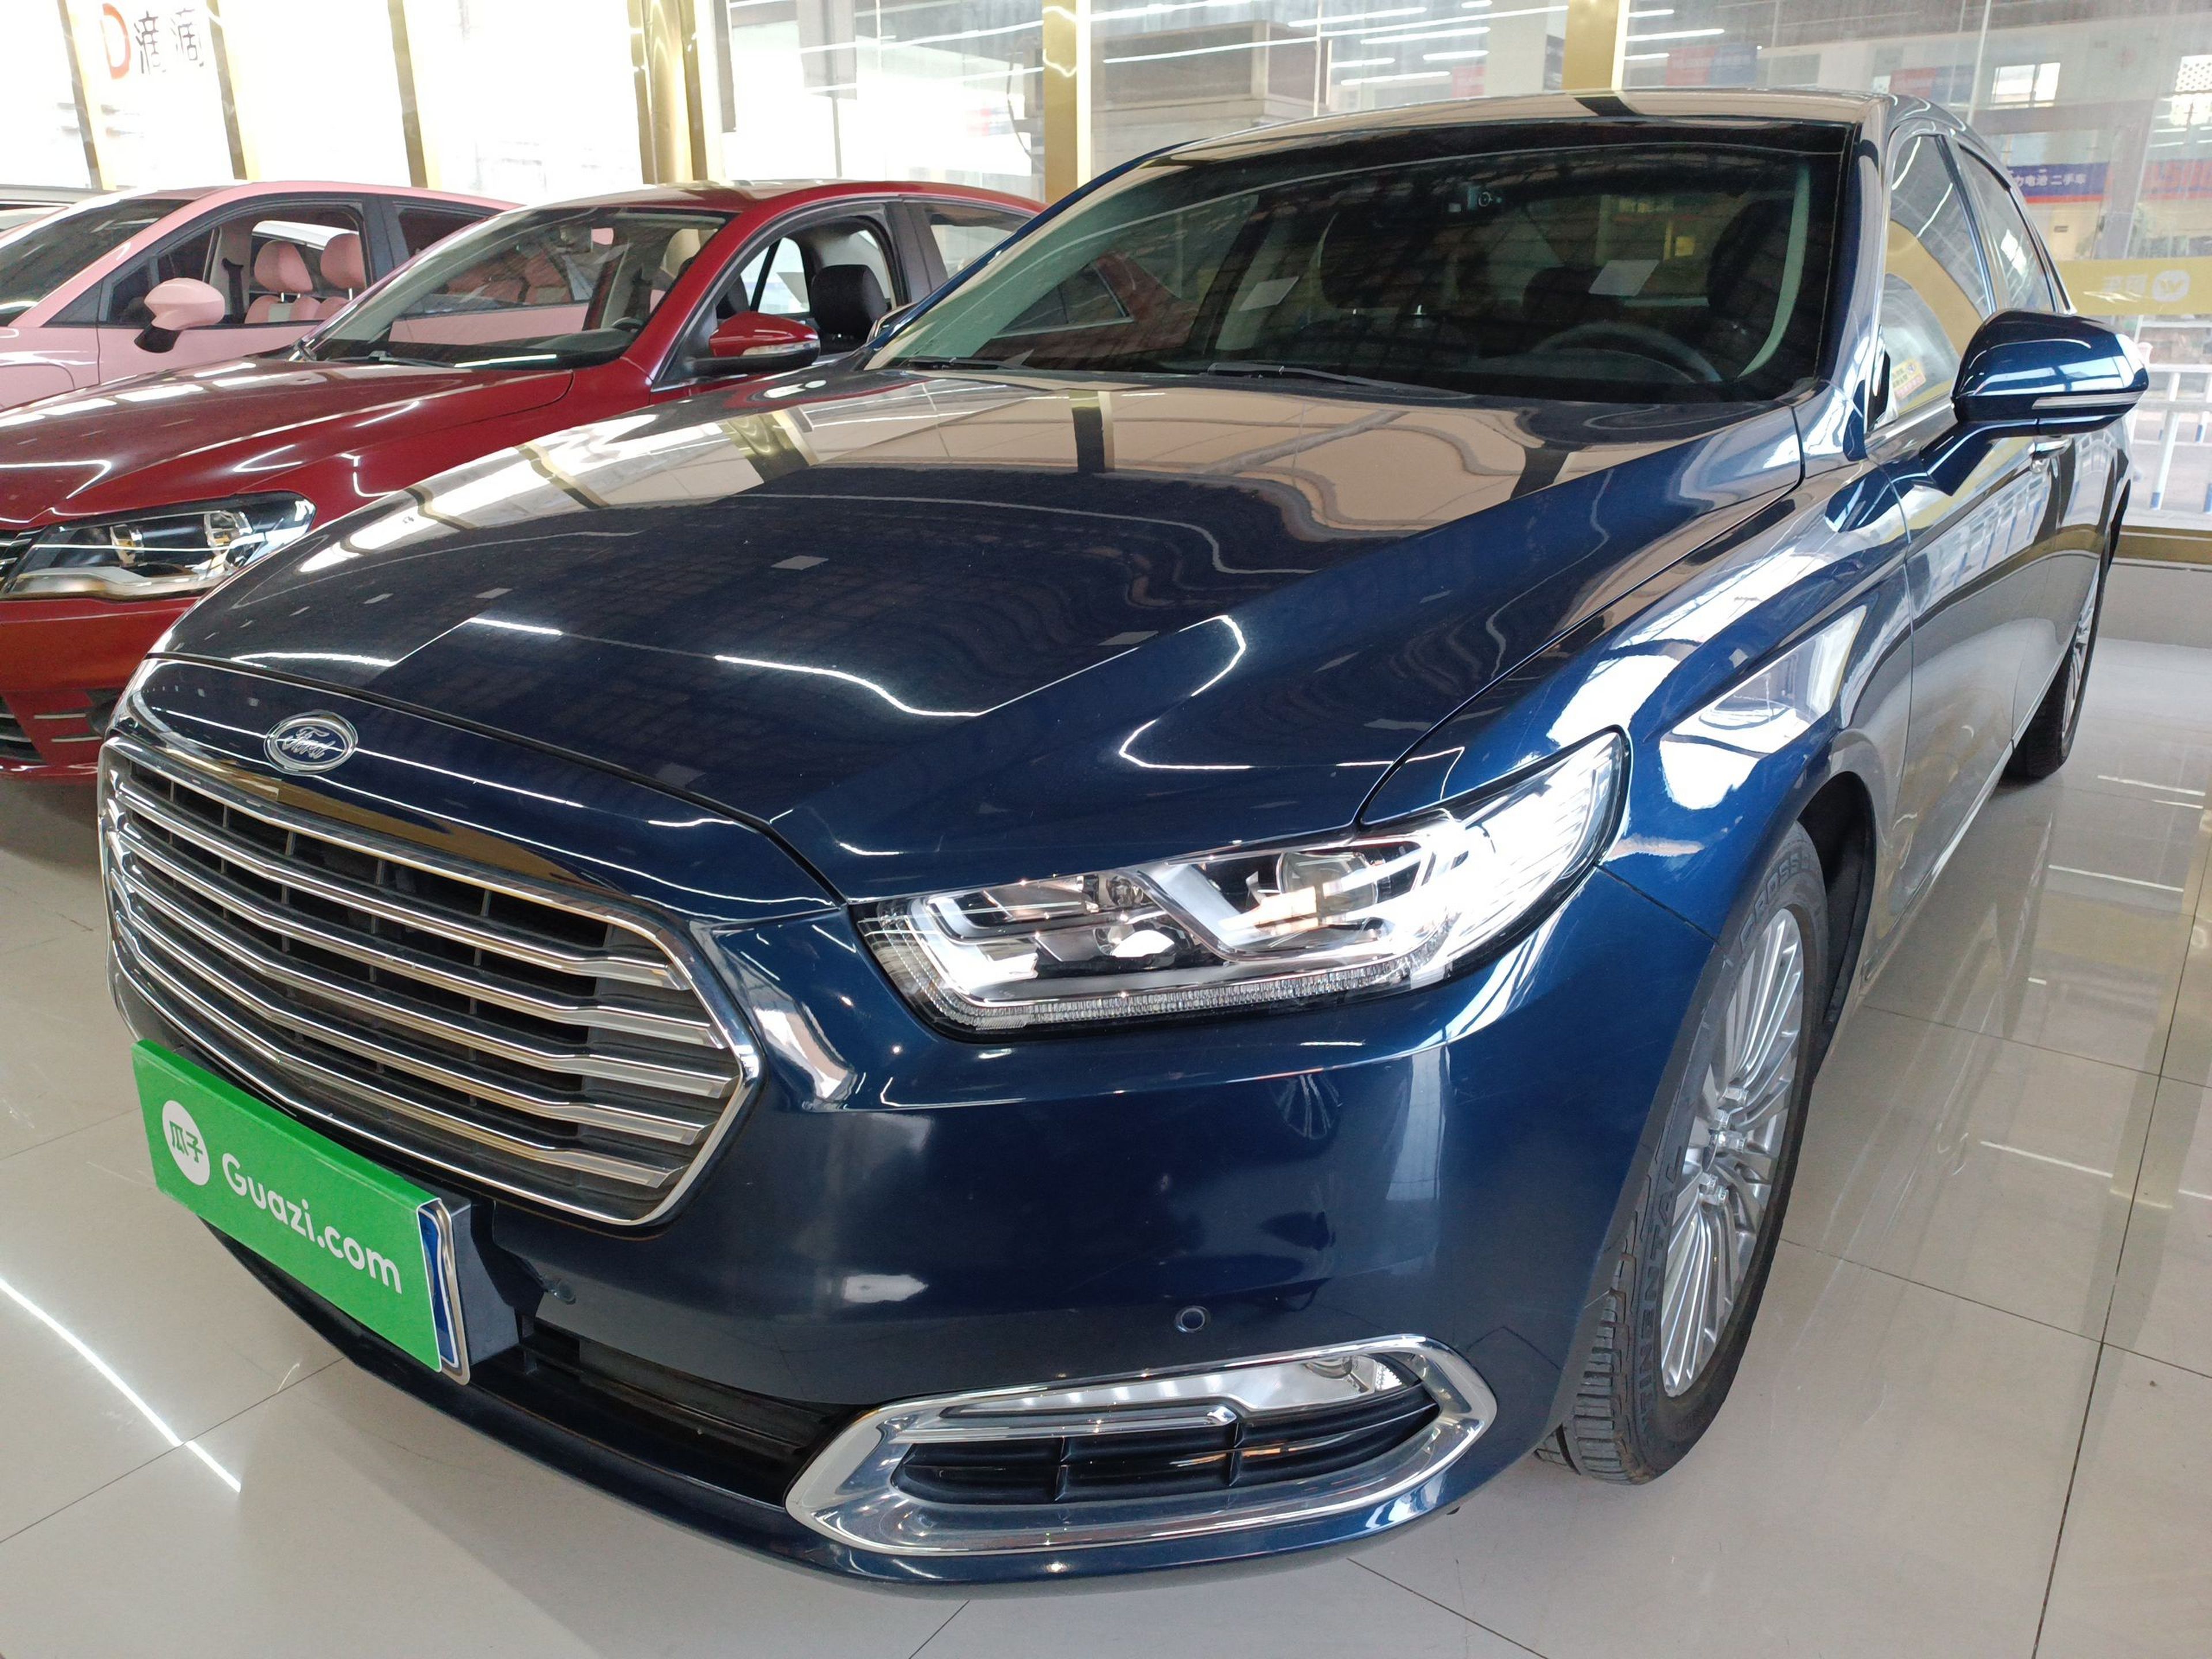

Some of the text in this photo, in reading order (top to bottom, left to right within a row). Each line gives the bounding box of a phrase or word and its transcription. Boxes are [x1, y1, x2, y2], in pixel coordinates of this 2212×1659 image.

[282, 726, 336, 759] Ford
[169, 1120, 203, 1163] 瓜子
[222, 1153, 402, 1294] Guazi.com
